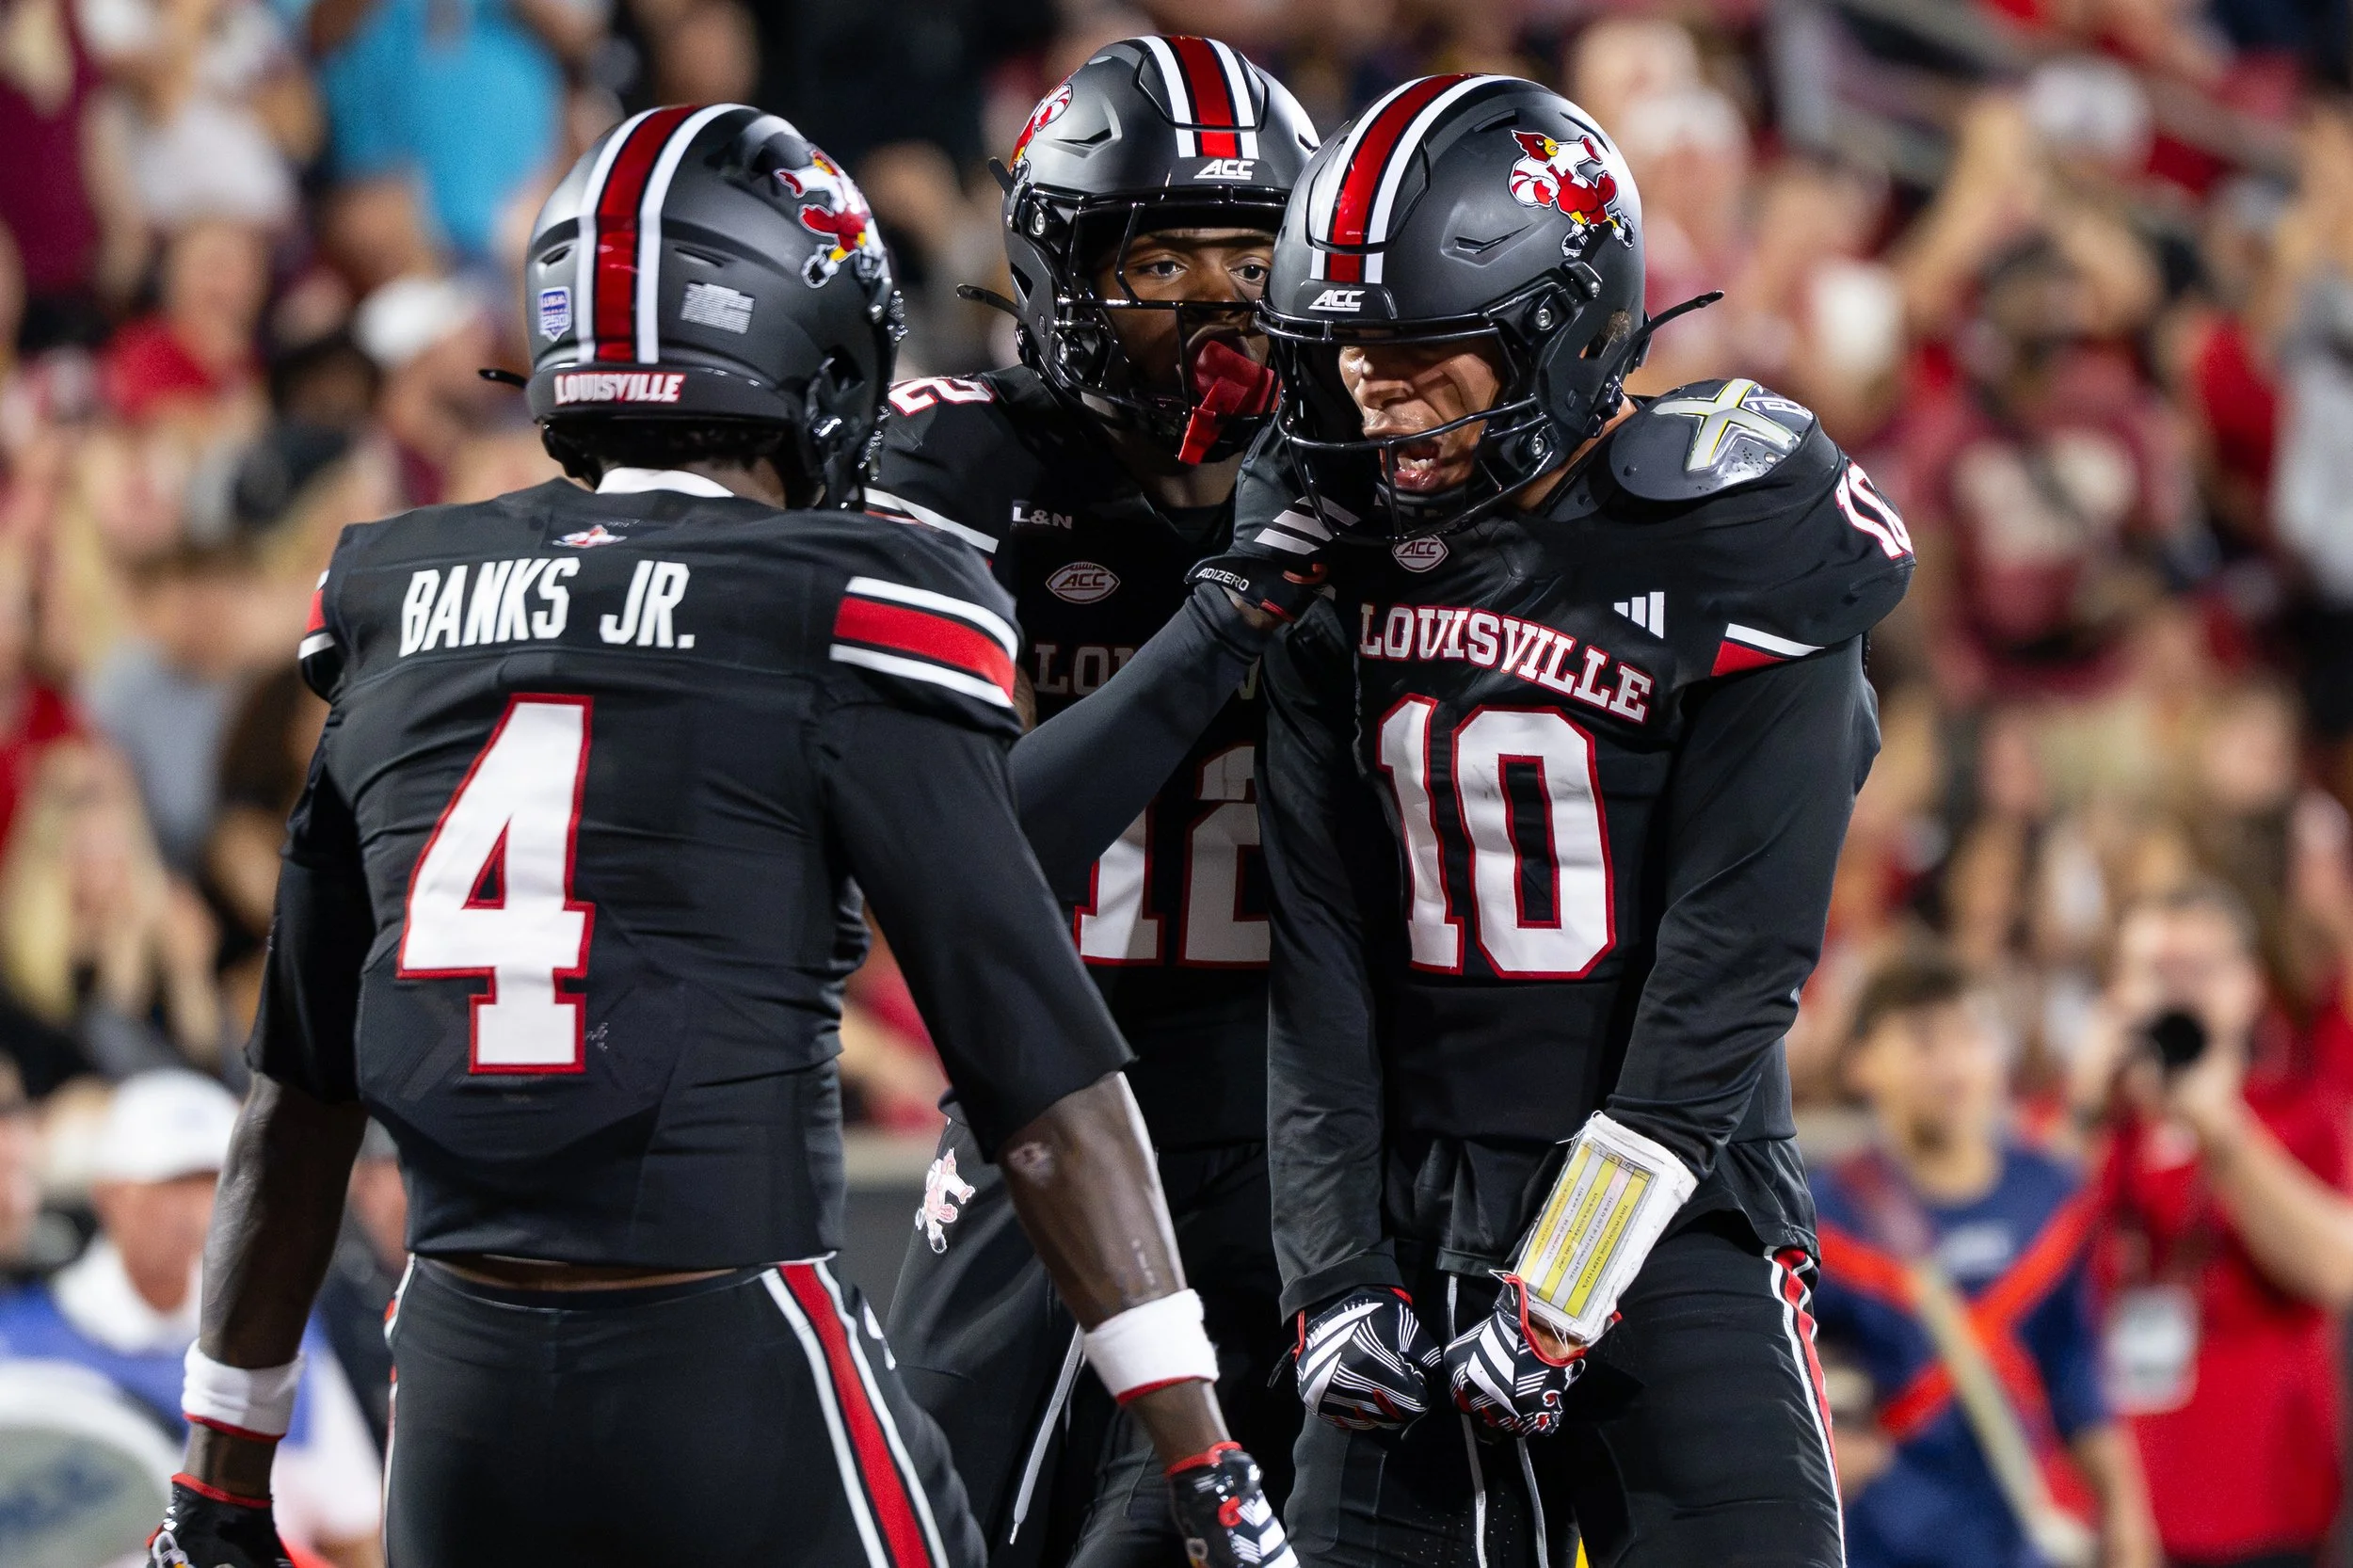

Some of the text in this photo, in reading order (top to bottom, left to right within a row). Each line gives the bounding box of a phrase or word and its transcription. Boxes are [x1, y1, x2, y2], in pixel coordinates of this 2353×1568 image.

[1193, 159, 1255, 180] ACC
[1308, 290, 1365, 312] ACC
[553, 372, 686, 406] LOUISVILLE
[1012, 506, 1073, 530] L&N
[1401, 541, 1439, 555] ACC
[1054, 572, 1109, 591] ACC
[1195, 568, 1250, 592] ADIZERO
[398, 556, 696, 659] BANKS JR.
[1358, 602, 1656, 726] LOUISVILLE
[1375, 692, 1617, 980] 10
[1074, 737, 1272, 969] 12
[395, 692, 595, 1076] 4
